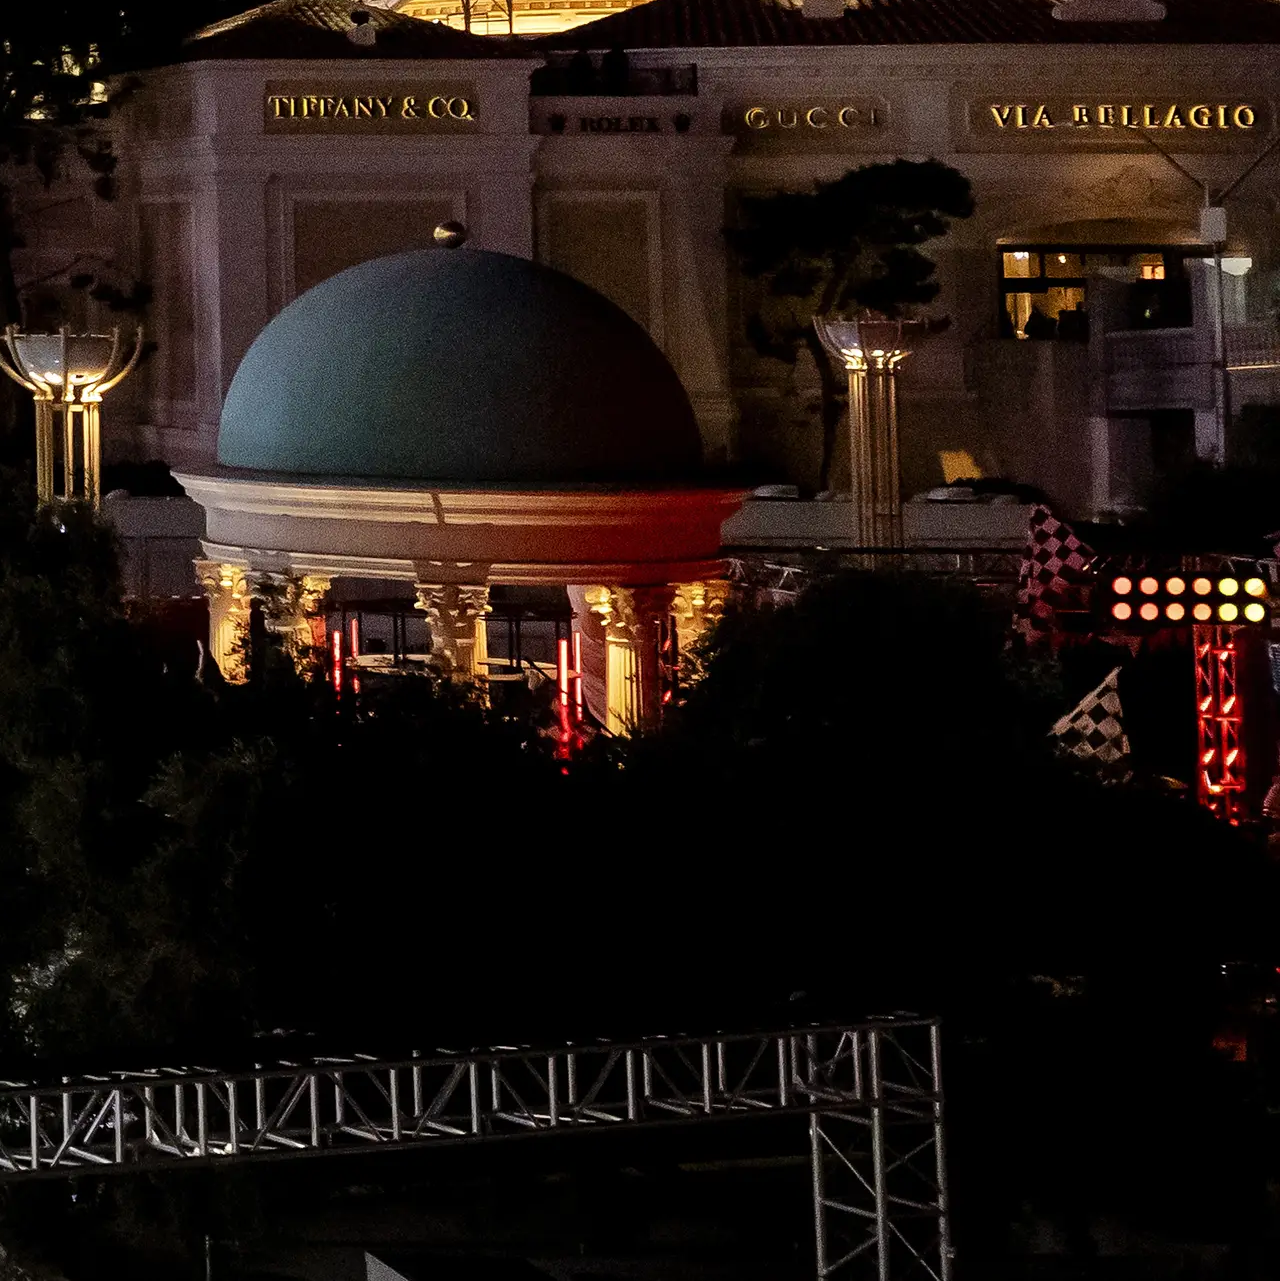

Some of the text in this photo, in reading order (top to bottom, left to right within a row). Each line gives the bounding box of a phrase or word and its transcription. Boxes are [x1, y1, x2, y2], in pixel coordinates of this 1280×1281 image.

[268, 96, 392, 119] TIFFANY
[401, 96, 420, 119] &
[745, 107, 876, 128] GUCCI
[991, 104, 1255, 129] VIA BELLAGIO
